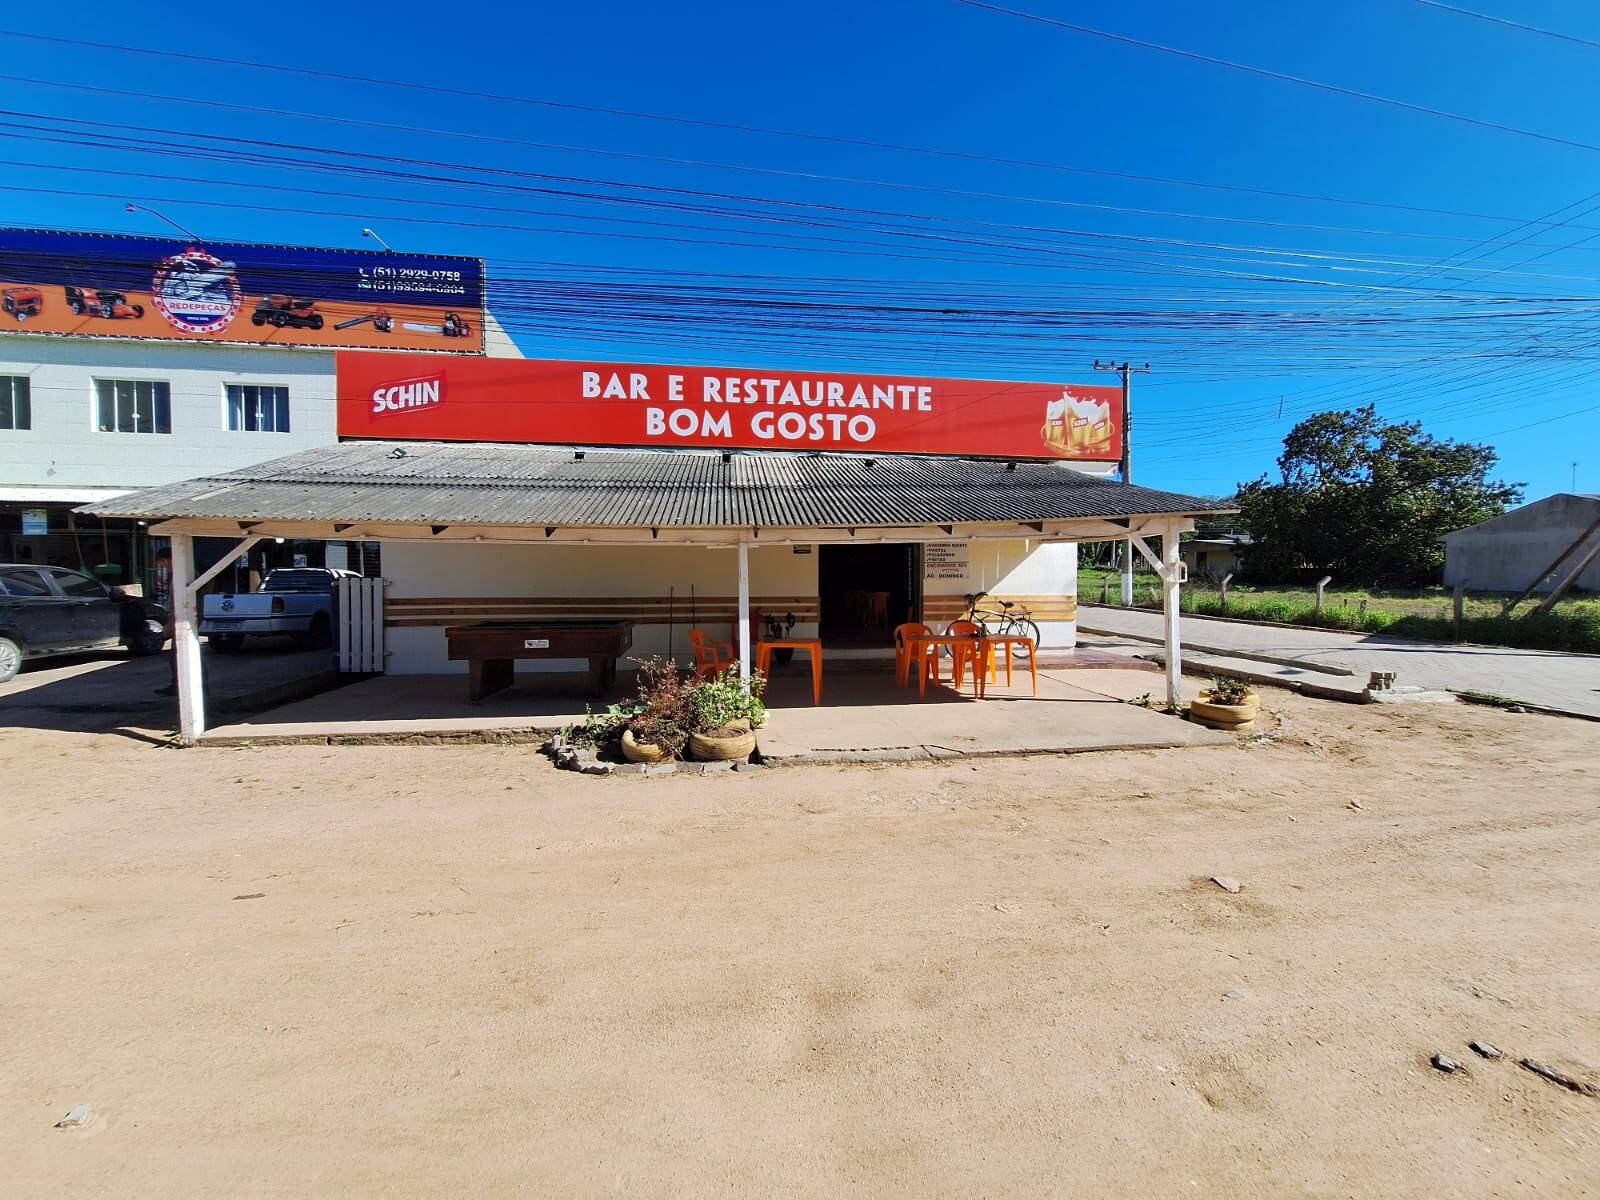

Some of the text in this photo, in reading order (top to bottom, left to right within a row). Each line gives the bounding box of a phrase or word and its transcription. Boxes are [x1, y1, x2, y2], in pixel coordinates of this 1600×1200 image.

[373, 266, 461, 281] (51) 2929-0758
[169, 302, 226, 313] REDEPEÇAS
[372, 380, 439, 413] SCHIN
[582, 371, 933, 412] BAR E RESTAURANTE
[646, 407, 877, 442] BOM GOSTO
